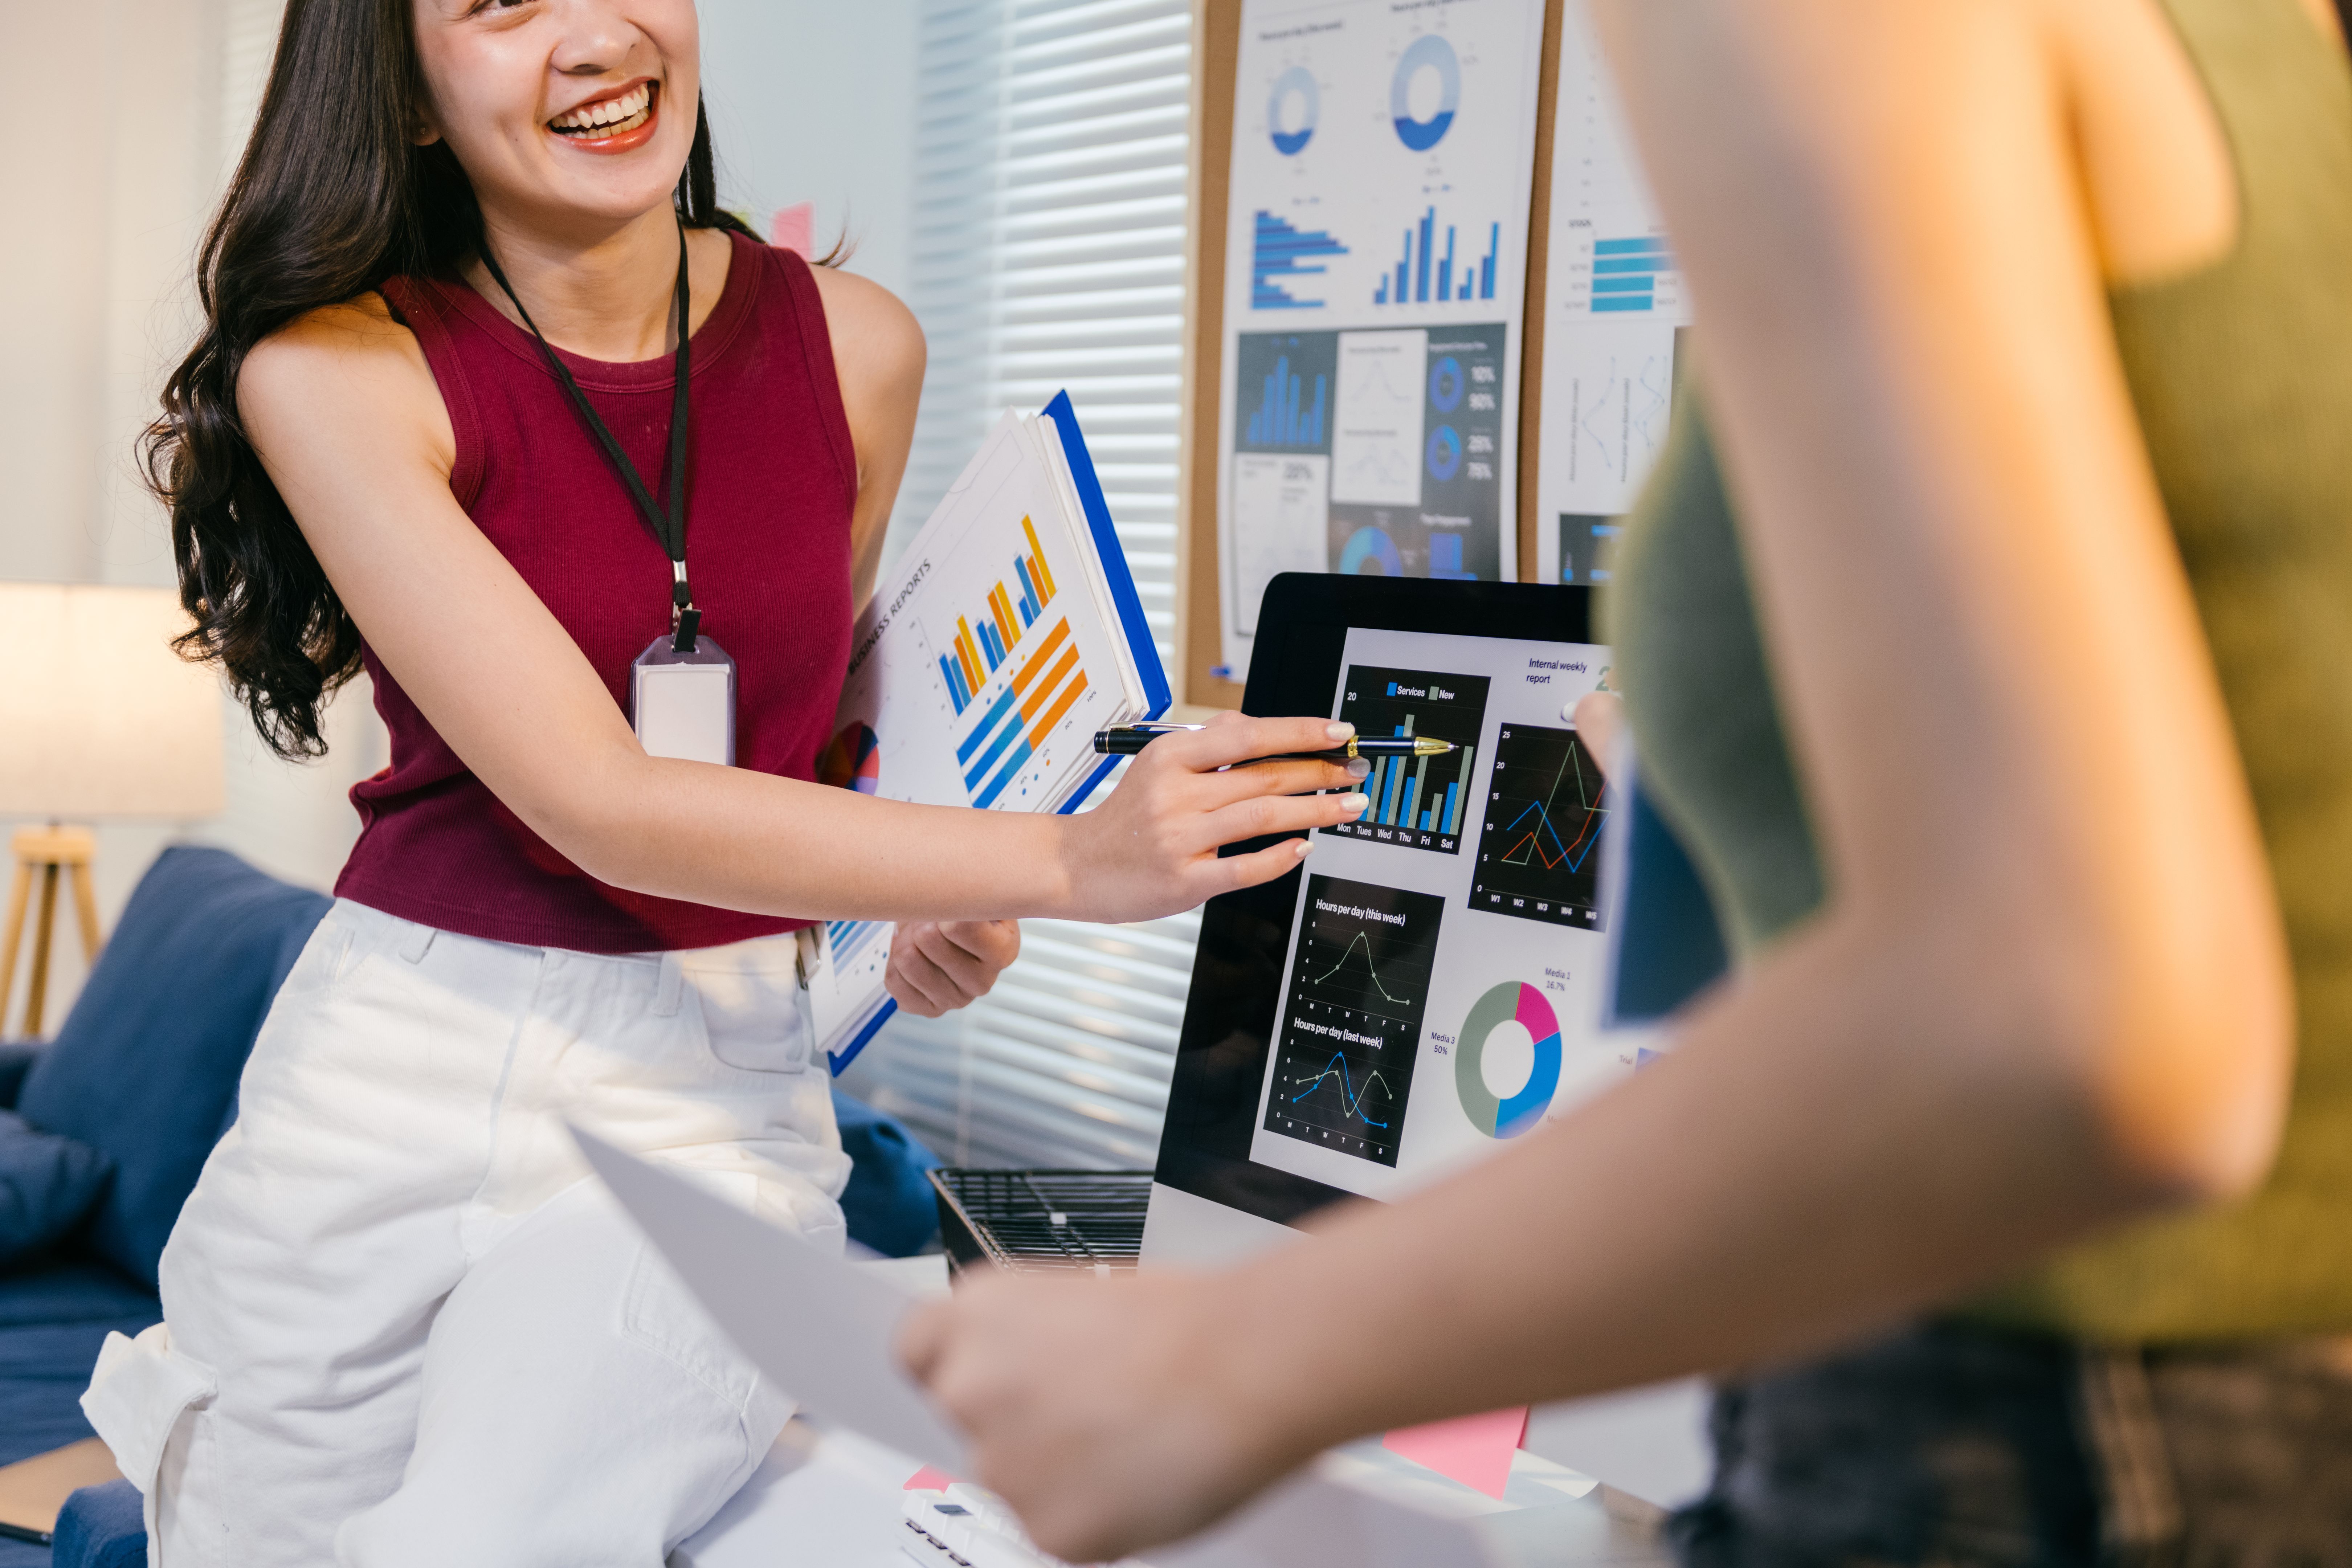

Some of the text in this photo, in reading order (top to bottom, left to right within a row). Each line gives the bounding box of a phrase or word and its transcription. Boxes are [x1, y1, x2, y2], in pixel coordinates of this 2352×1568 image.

[848, 558, 931, 675] BUSINESS REPORTS
[1529, 658, 1588, 673] Internal weekly
[1526, 674, 1551, 684] report
[1087, 690, 1097, 702] 100%
[1347, 692, 1357, 701] 20
[1397, 686, 1454, 699] Services New
[1337, 823, 1453, 849] Mon Tues Wed Thu Fri Sat
[1514, 899, 1524, 907] W2
[1537, 902, 1548, 911] W3
[1316, 899, 1405, 926] Hours per day (this week)
[1545, 967, 1566, 979] Media
[1546, 980, 1565, 991] 16.7%
[1294, 1017, 1383, 1049] Hours per day (last week)
[1431, 1032, 1450, 1043] Media
[1434, 1045, 1448, 1055] 50%
[1619, 1055, 1633, 1064] Trial
